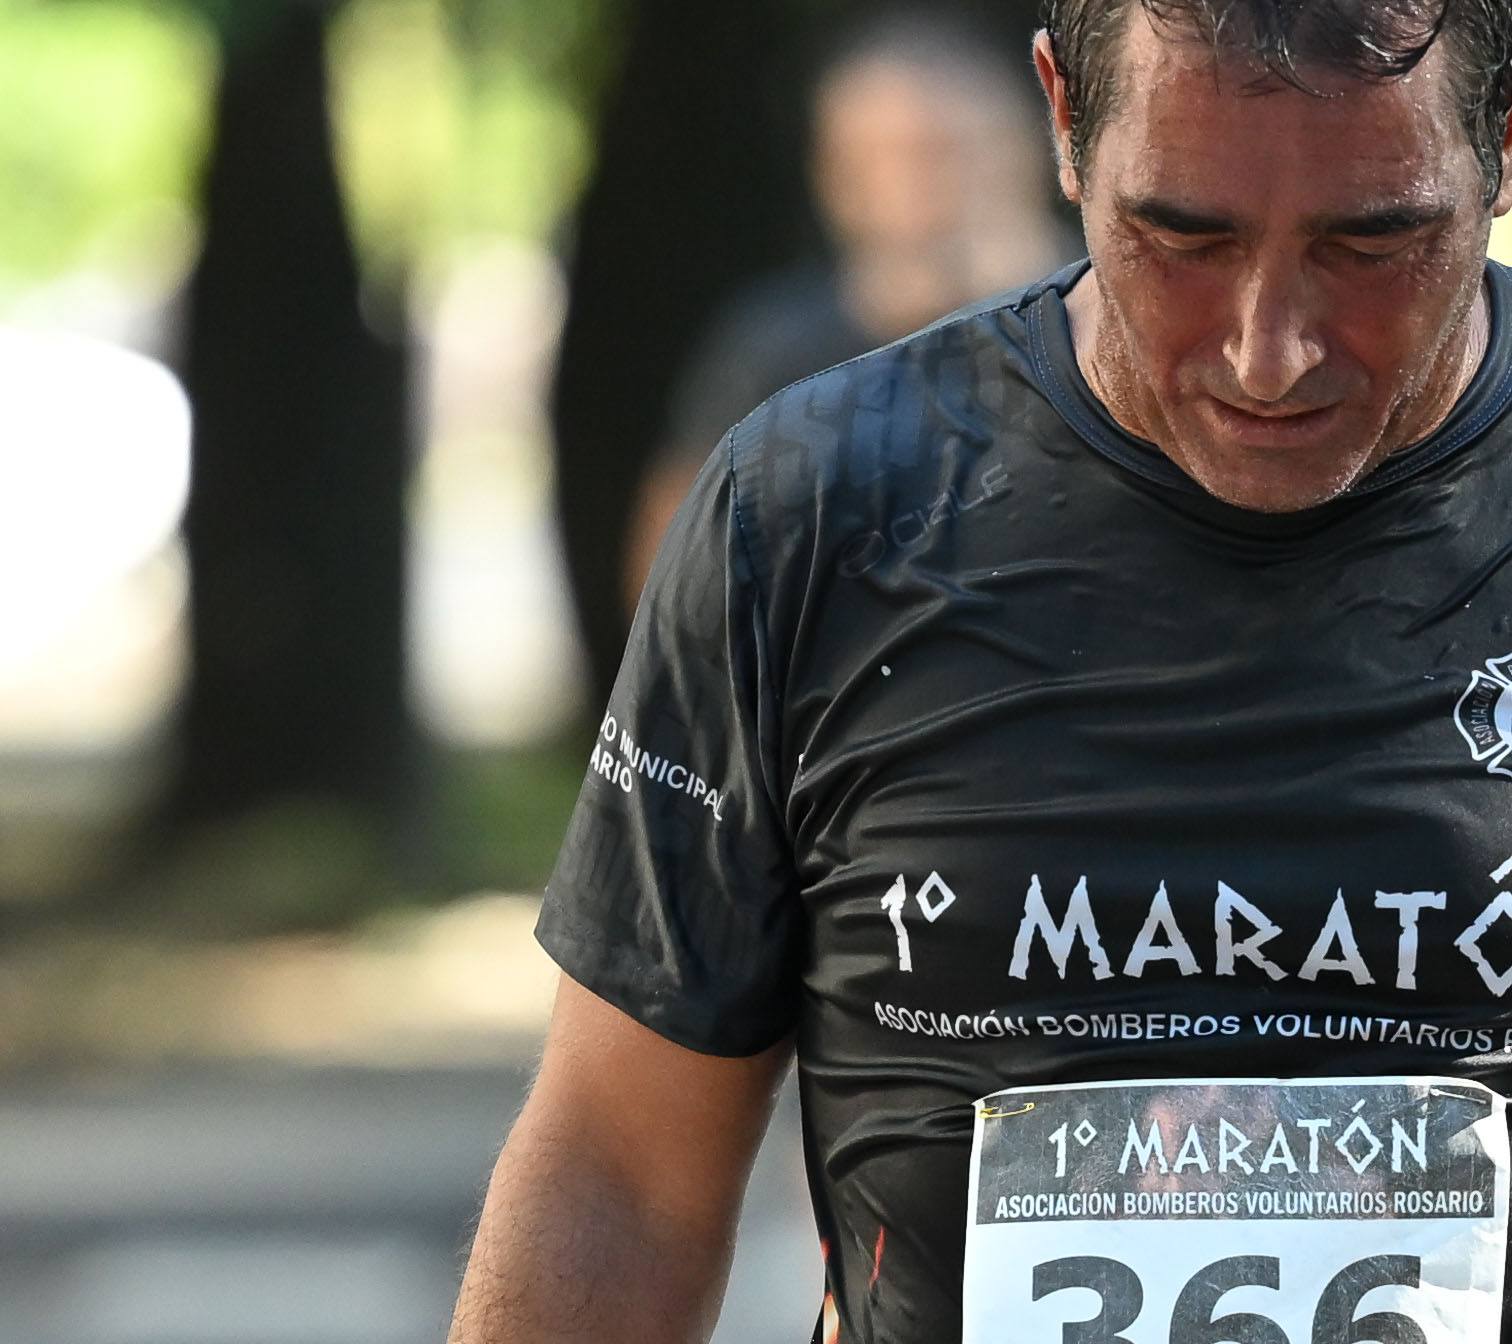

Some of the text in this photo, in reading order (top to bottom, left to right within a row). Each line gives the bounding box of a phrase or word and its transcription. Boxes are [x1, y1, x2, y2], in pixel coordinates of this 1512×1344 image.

[619, 729, 723, 821] MUNICIPAL
[874, 1001, 1030, 1040] ASOCIACIÓN
[1037, 1013, 1241, 1040] BOMBEROS
[1252, 1014, 1494, 1052] VOLUNTARIOS
[1117, 1099, 1428, 1176] MARATÓN
[1123, 1191, 1238, 1215] BOMBEROS
[1245, 1191, 1387, 1215] VOLUNTARIOS
[1393, 1190, 1484, 1214] ROSARIO
